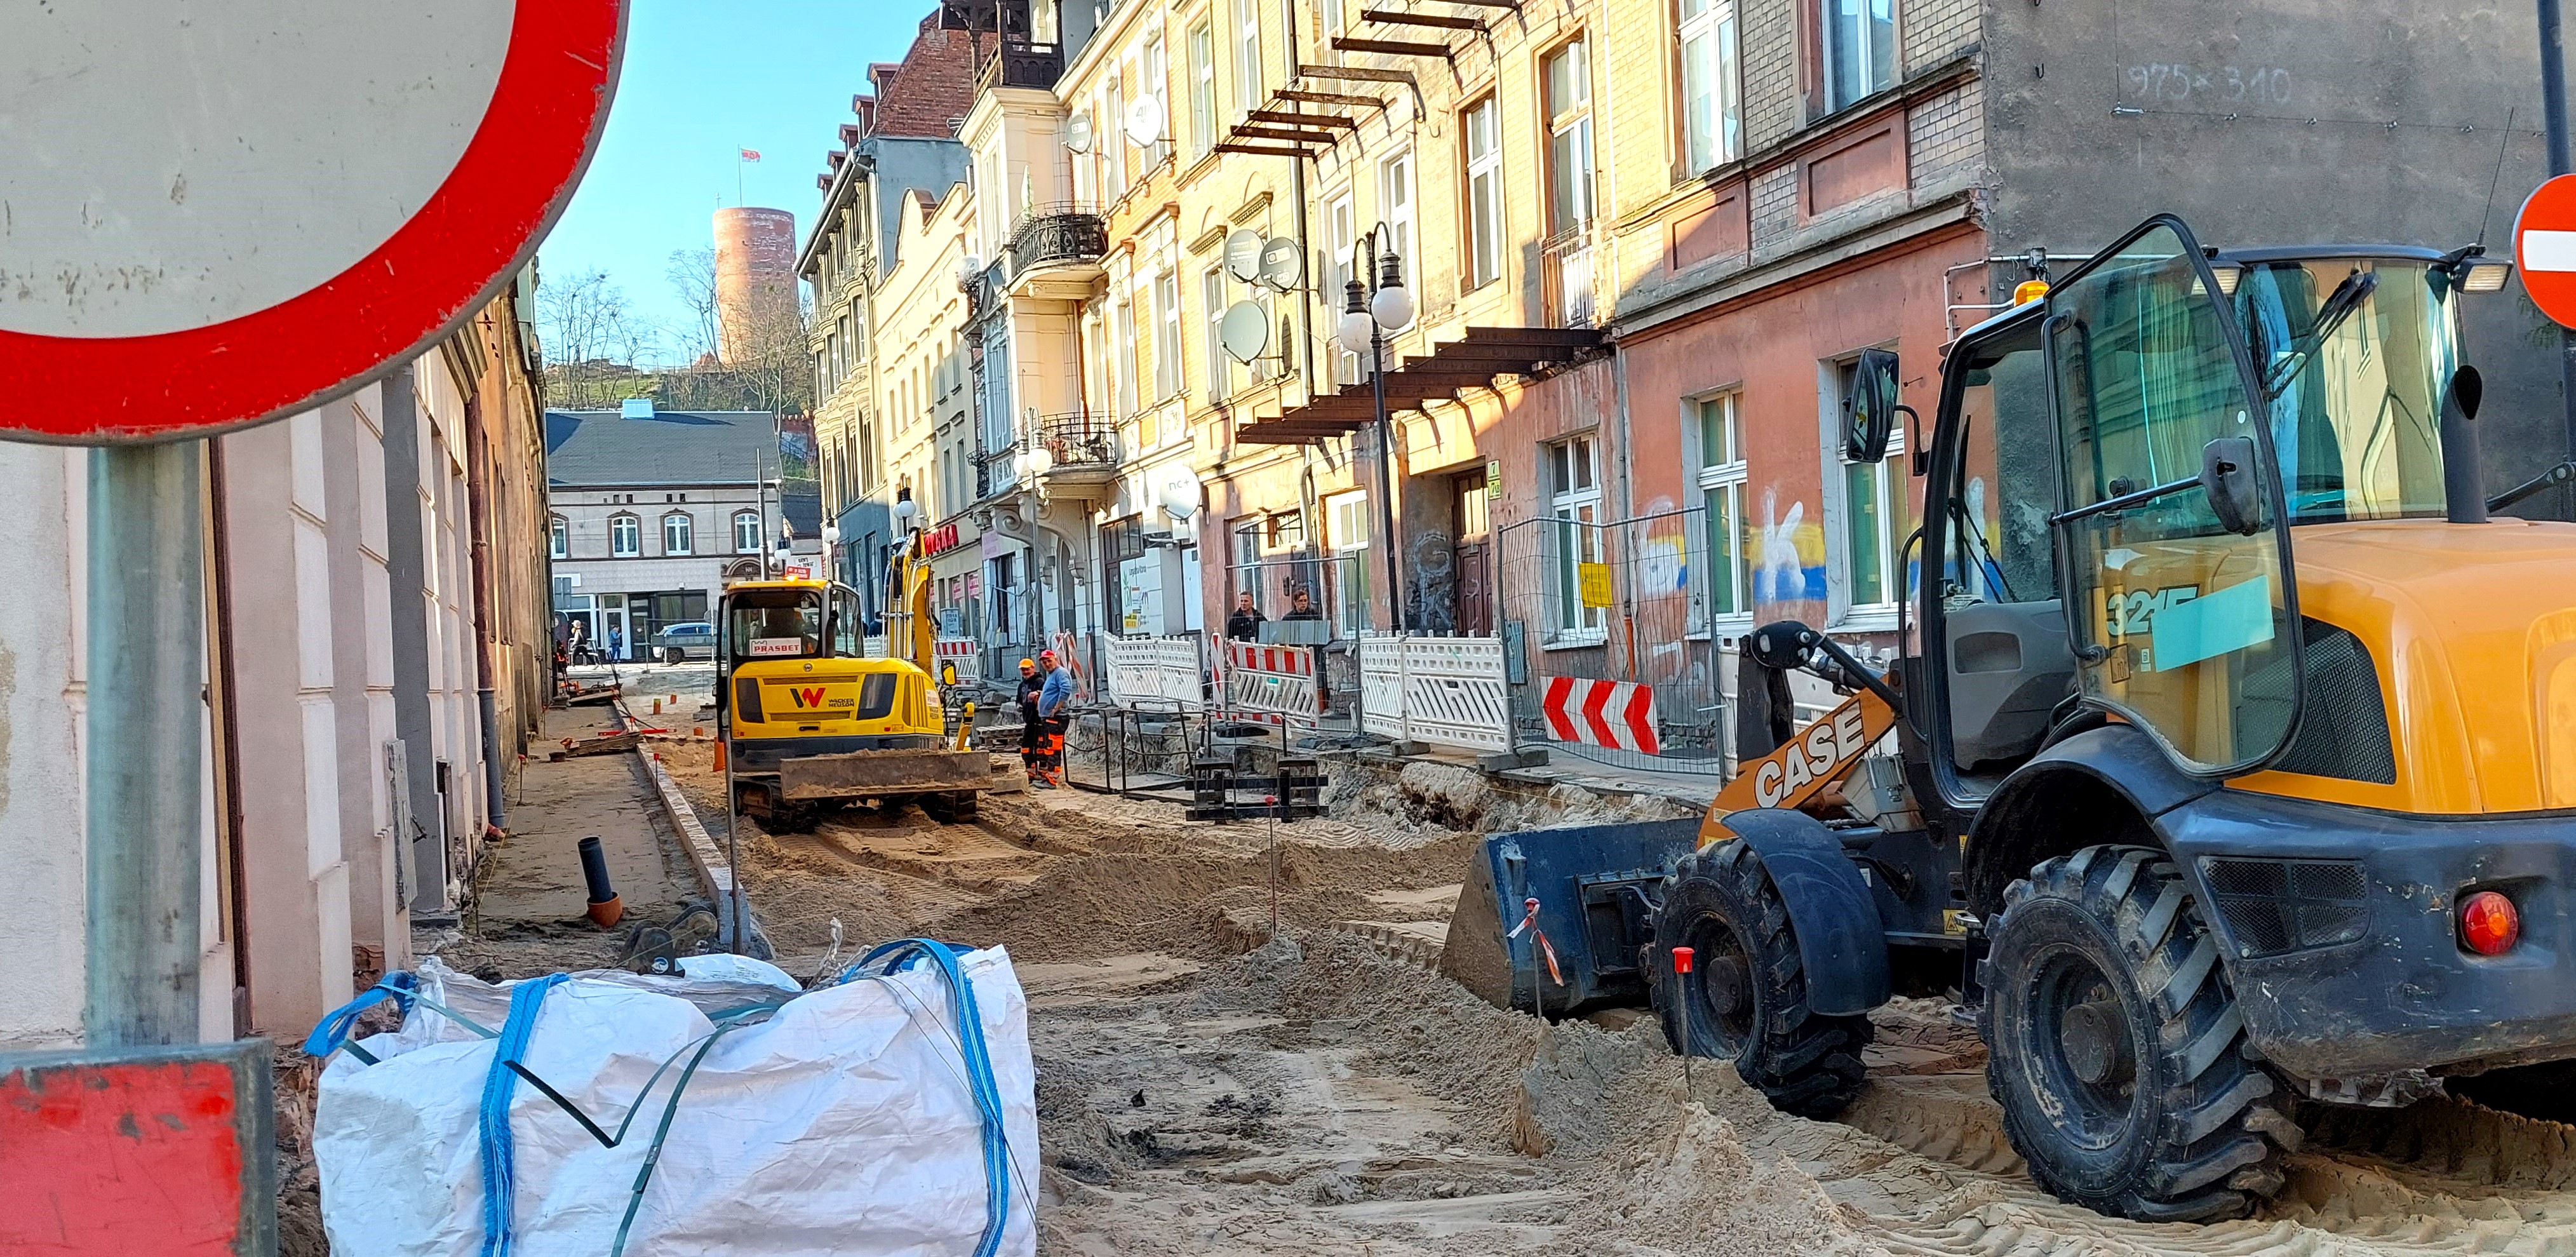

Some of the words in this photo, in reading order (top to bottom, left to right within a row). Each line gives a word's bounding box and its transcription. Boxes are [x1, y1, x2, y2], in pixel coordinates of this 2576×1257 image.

[1491, 462, 1495, 474] 7
[1169, 478, 1189, 490] nc+
[1755, 699, 1865, 809] CASE
